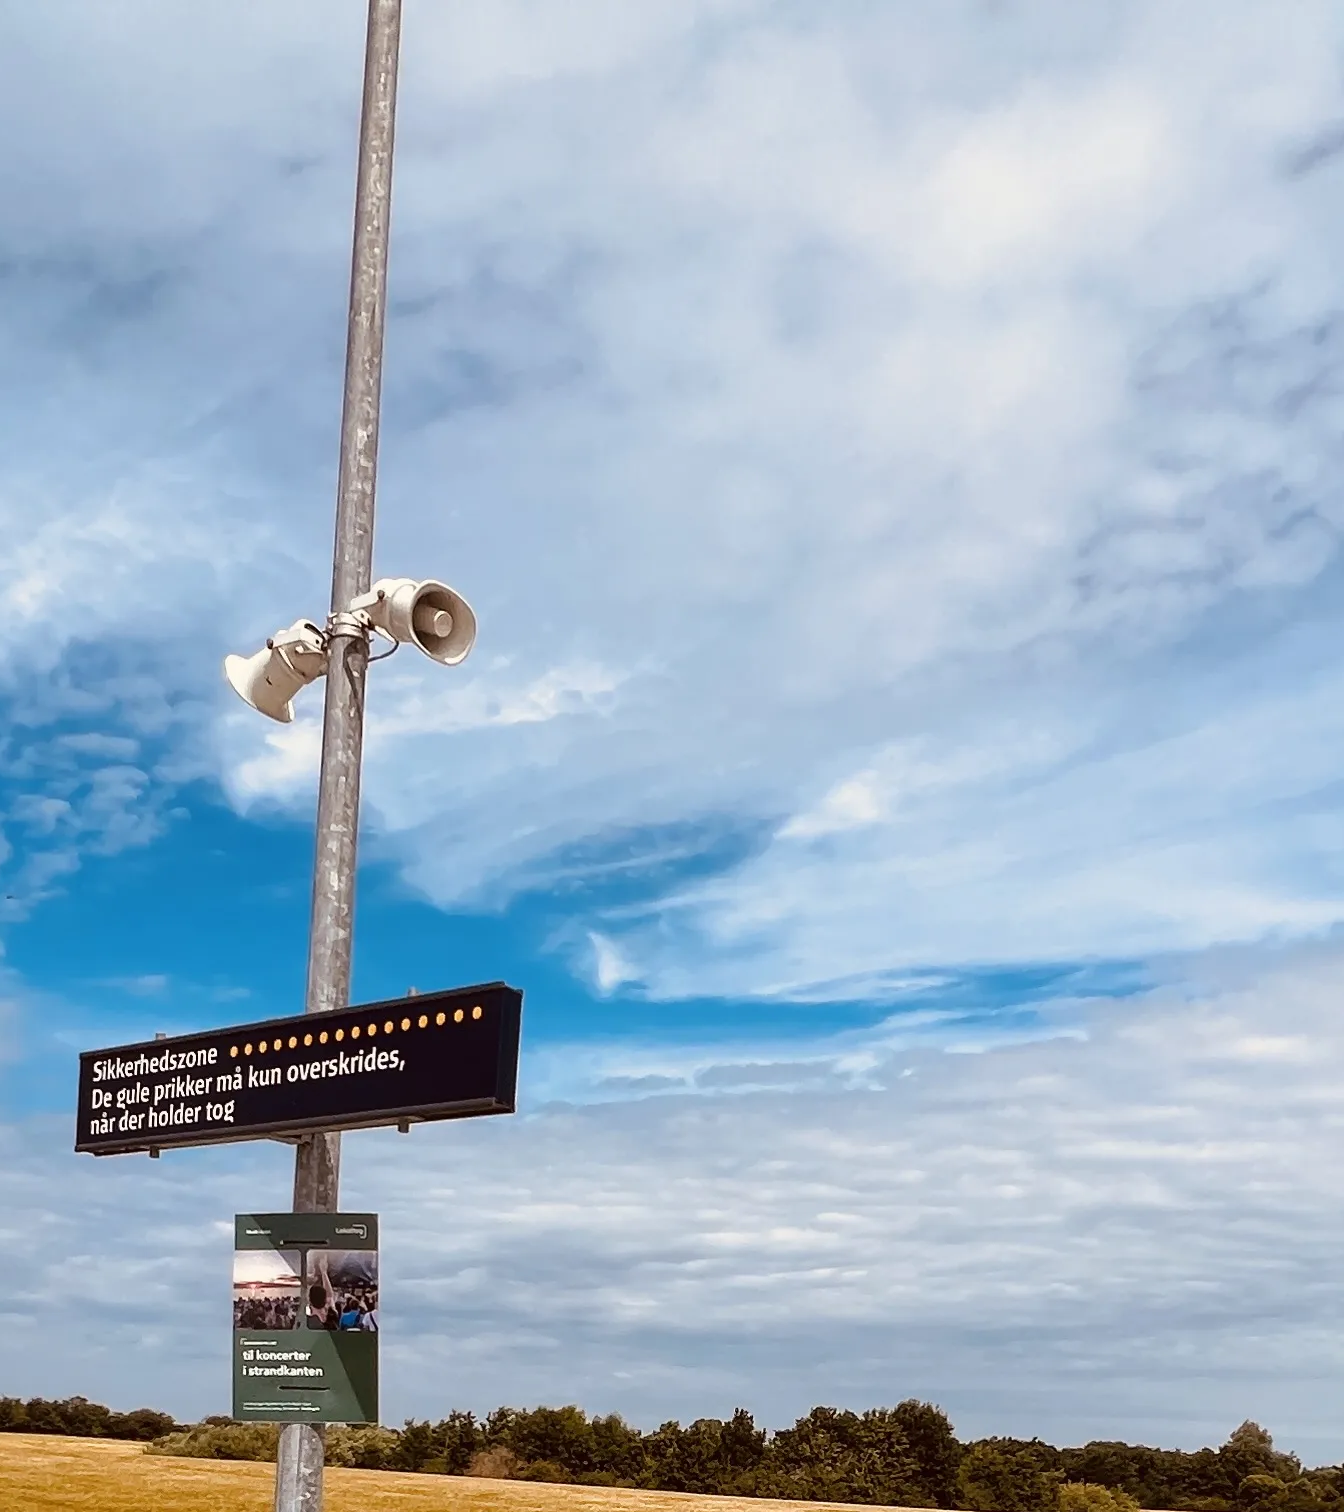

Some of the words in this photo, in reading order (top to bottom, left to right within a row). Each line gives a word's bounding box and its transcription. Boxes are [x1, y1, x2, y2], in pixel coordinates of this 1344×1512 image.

[91, 1088, 113, 1109] De
[116, 1082, 150, 1109] gule
[154, 1074, 213, 1106] prikker
[216, 1066, 243, 1093] må
[248, 1065, 282, 1088] kun
[286, 1046, 405, 1083] overskrides,
[92, 1047, 218, 1082] Sikkerhedszone
[90, 1112, 116, 1135] når
[118, 1110, 145, 1132] der
[148, 1102, 202, 1128] holder
[205, 1100, 235, 1123] tog
[242, 1349, 254, 1361] til
[256, 1349, 312, 1361] koncerter
[242, 1365, 247, 1376] i
[248, 1364, 323, 1377] strandkanten
